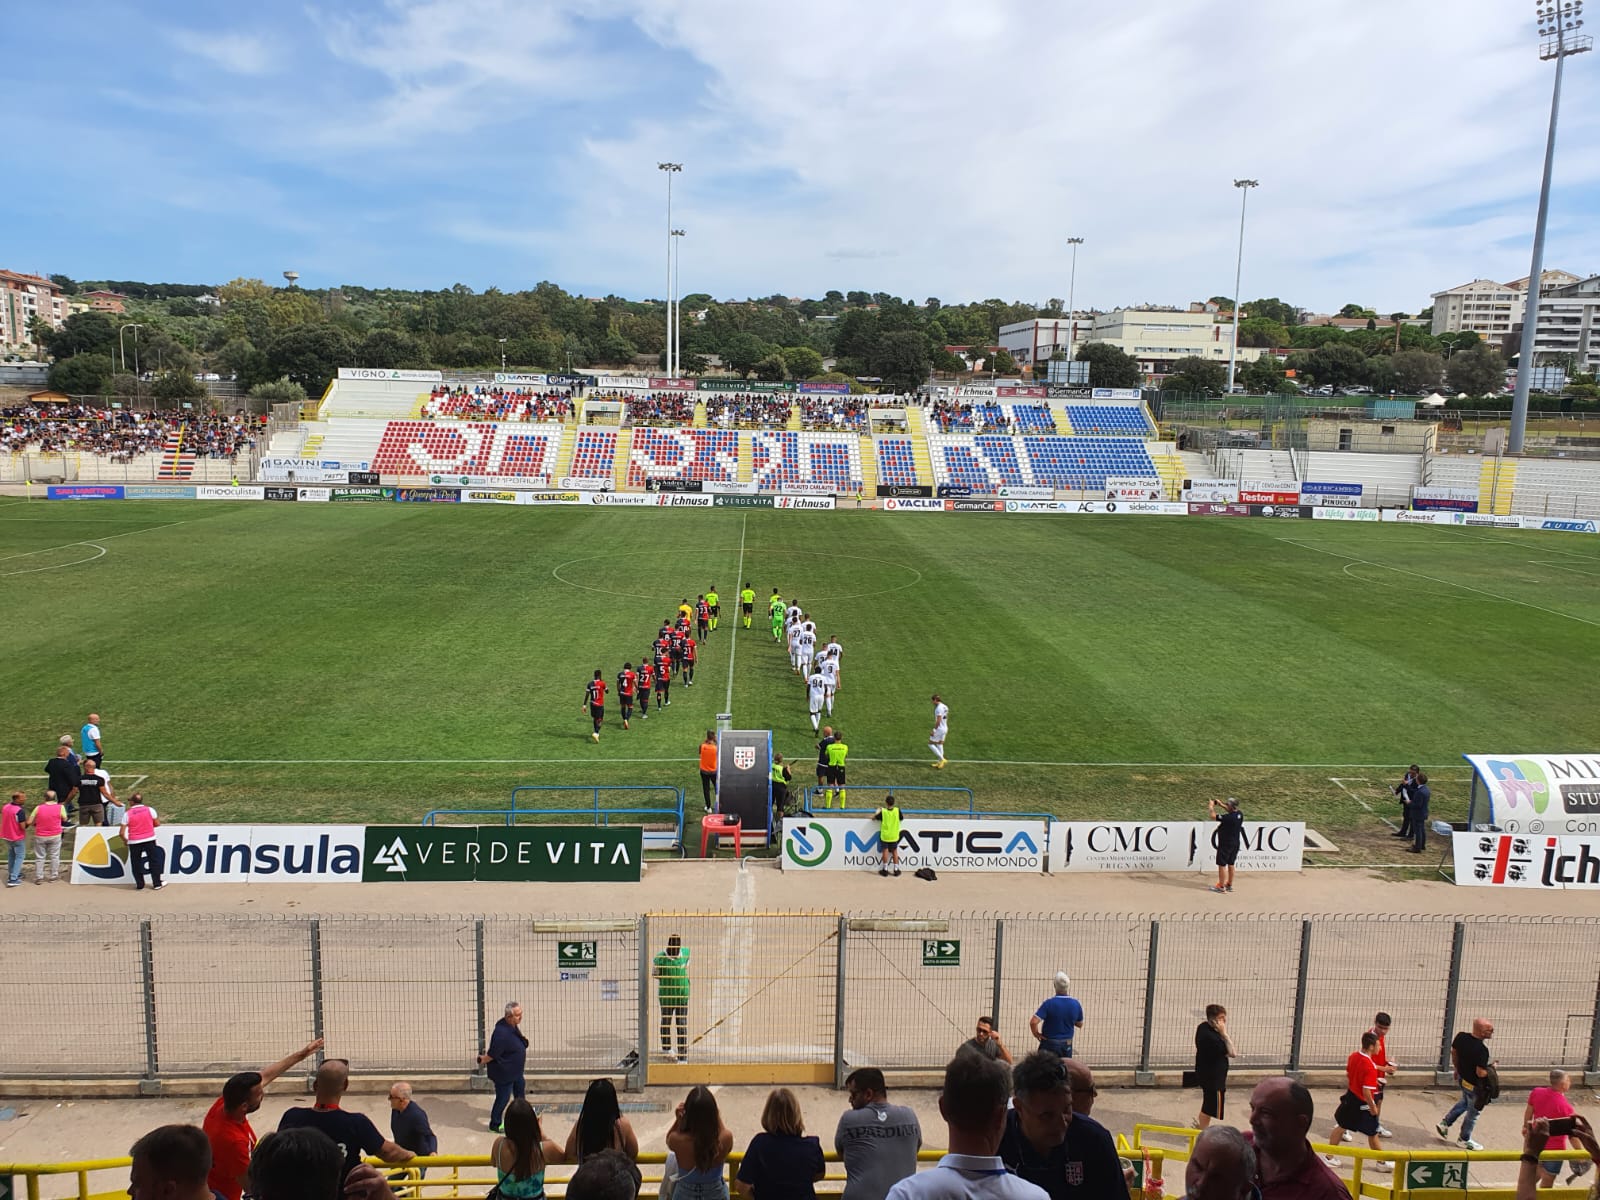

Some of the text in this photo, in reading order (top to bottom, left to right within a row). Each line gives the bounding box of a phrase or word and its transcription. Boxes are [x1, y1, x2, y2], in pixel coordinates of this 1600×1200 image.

[606, 494, 646, 504] Character
[752, 497, 773, 505] VITA
[1240, 492, 1274, 502] Testoni
[897, 500, 942, 508] VACLIM
[953, 501, 995, 509] GermanCar
[1321, 498, 1357, 507] PINUCCIO
[793, 630, 801, 638] 27
[804, 637, 812, 645] 26
[660, 666, 665, 674] 5
[828, 666, 833, 674] 9
[622, 679, 627, 687] 4
[812, 679, 823, 688] 94
[844, 830, 1038, 854] MATICA
[1087, 826, 1168, 853] CMC
[416, 841, 630, 865] VERDE VITA
[844, 855, 1038, 868] MUOVAMO IL VOSTRO MONDO
